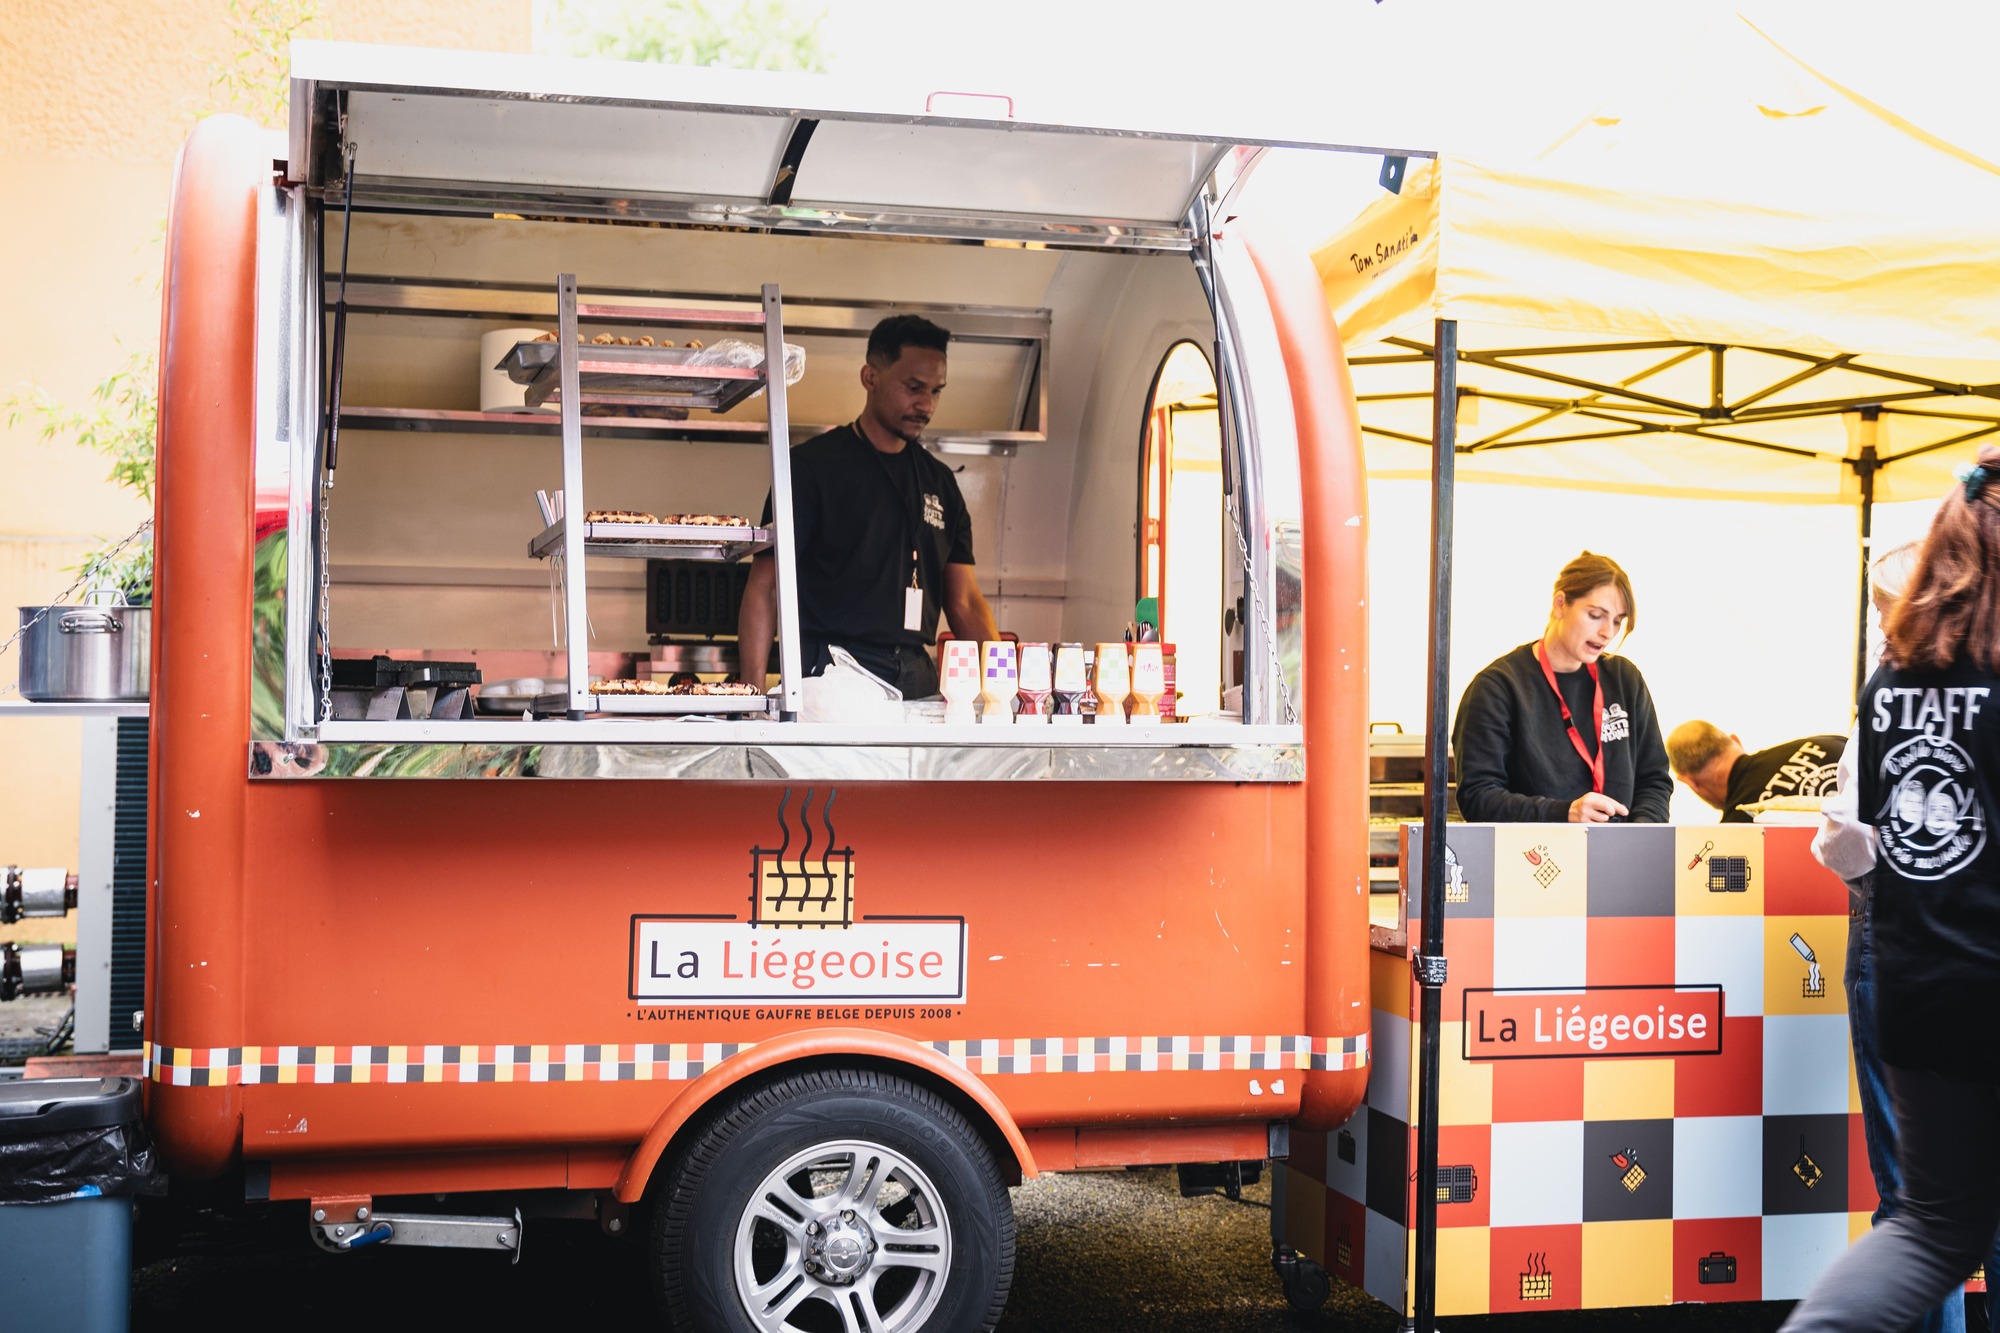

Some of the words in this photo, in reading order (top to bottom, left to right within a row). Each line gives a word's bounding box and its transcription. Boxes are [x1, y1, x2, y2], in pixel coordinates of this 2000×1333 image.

[1350, 253, 1374, 274] Tom
[1375, 233, 1409, 263] Sanati
[1872, 687, 1991, 747] STAFF
[650, 940, 700, 979] La
[723, 938, 943, 990] Liégeoise
[637, 1009, 751, 1022] L'AUTHENTIQUE
[755, 1009, 812, 1020] GAUFRE
[816, 1009, 860, 1019] BELGE
[865, 1008, 916, 1019] DEPUIS
[920, 1008, 952, 1019] 2008
[1478, 1009, 1518, 1043] La
[1534, 1004, 1708, 1051] Liégeoise
